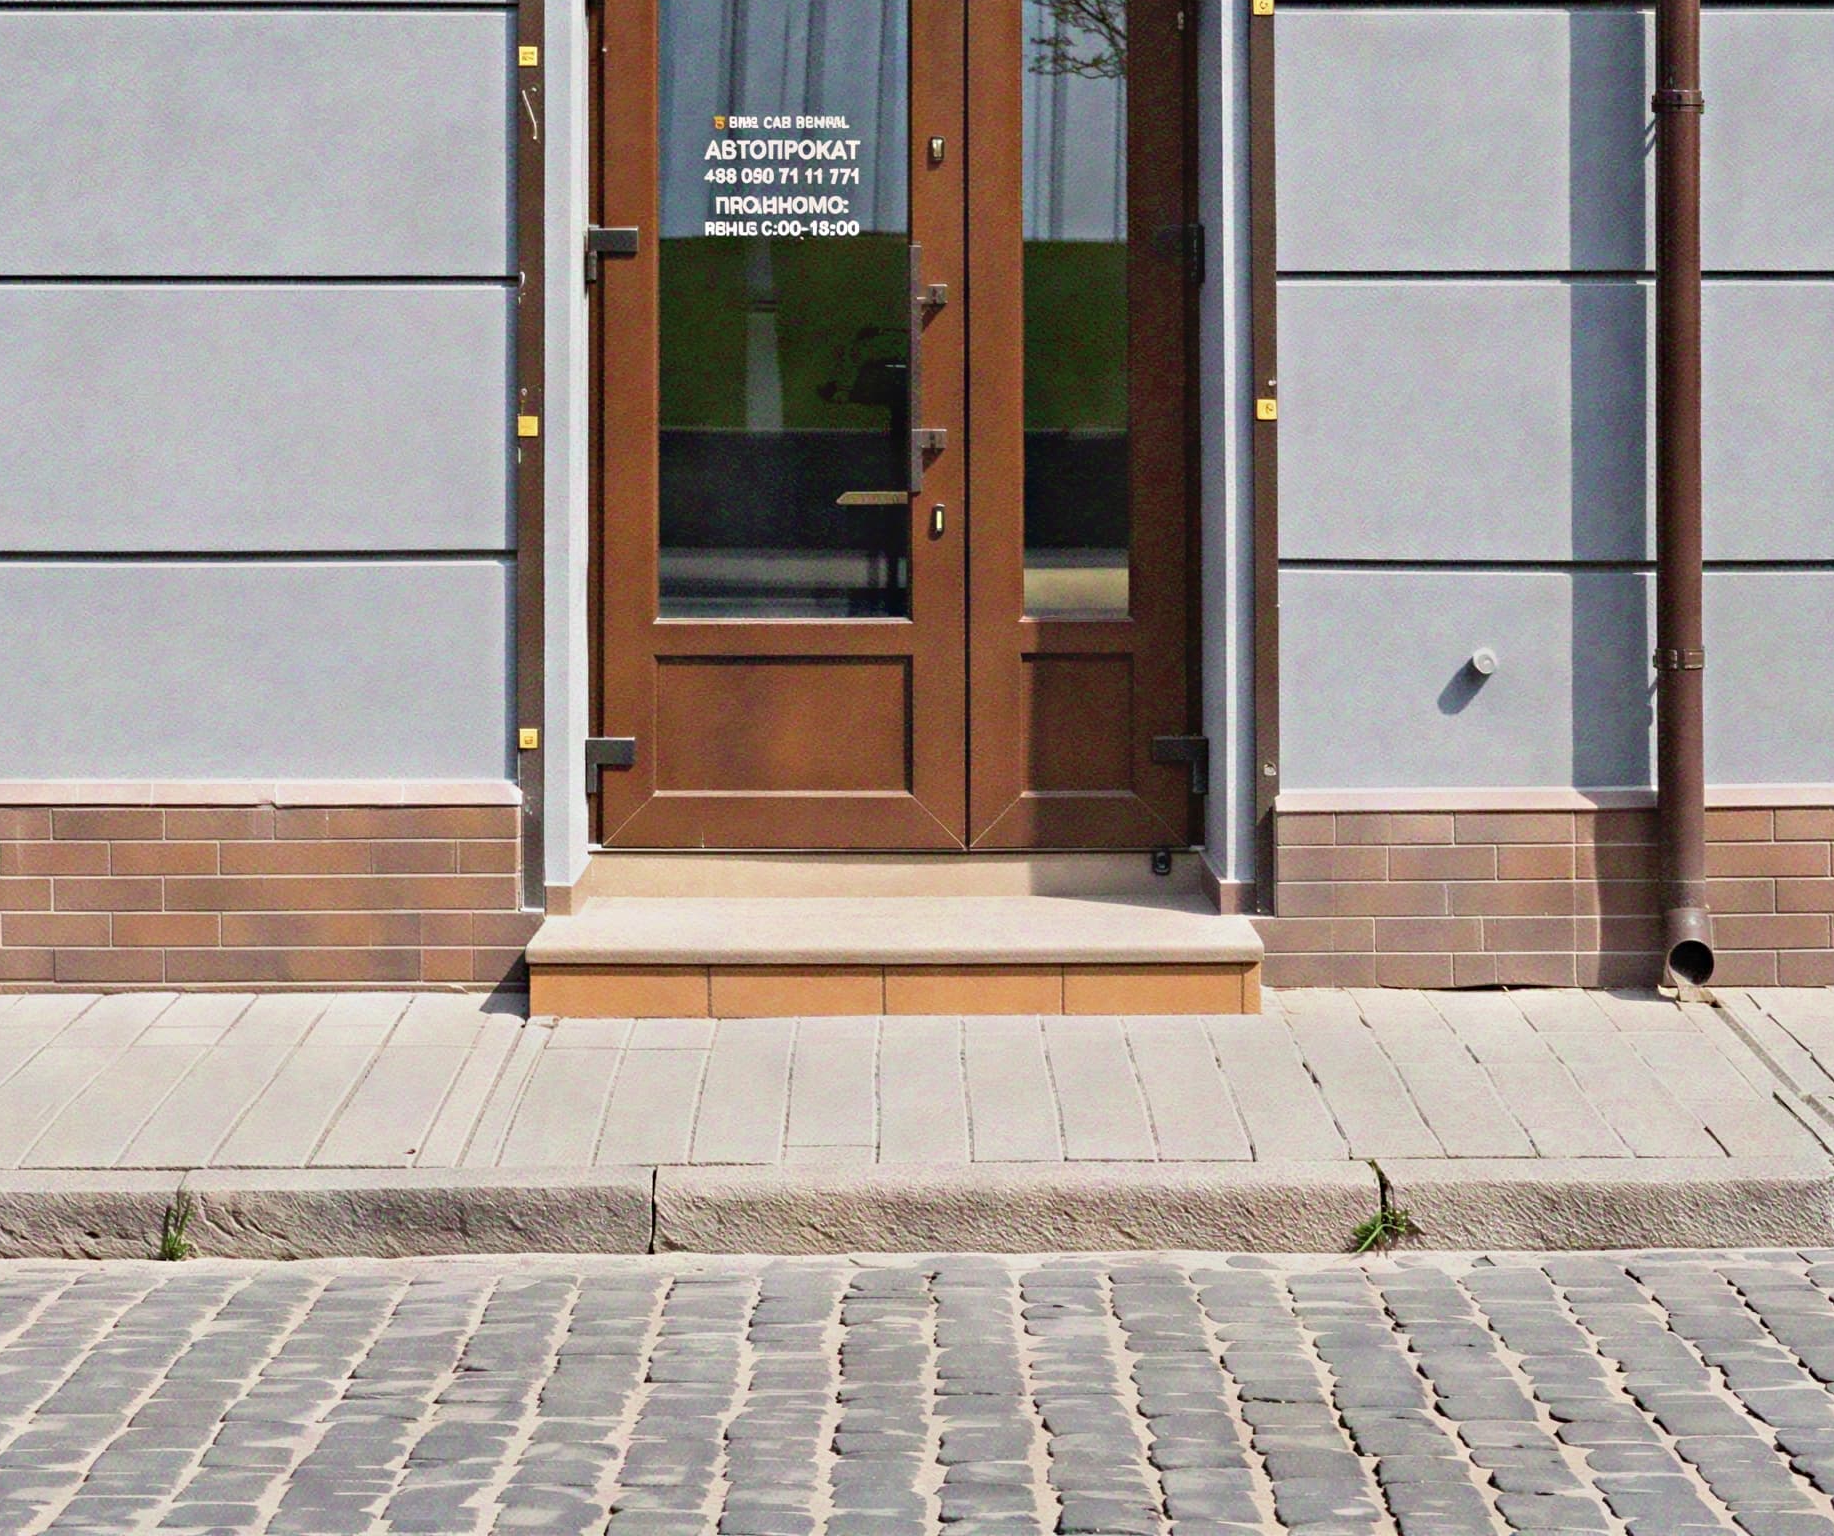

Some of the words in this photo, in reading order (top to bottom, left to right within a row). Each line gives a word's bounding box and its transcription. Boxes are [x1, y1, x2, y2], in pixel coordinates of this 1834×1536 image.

[704, 139, 861, 161] АВТОПРОКАТ
[779, 168, 799, 185] 71
[804, 168, 823, 185] 11
